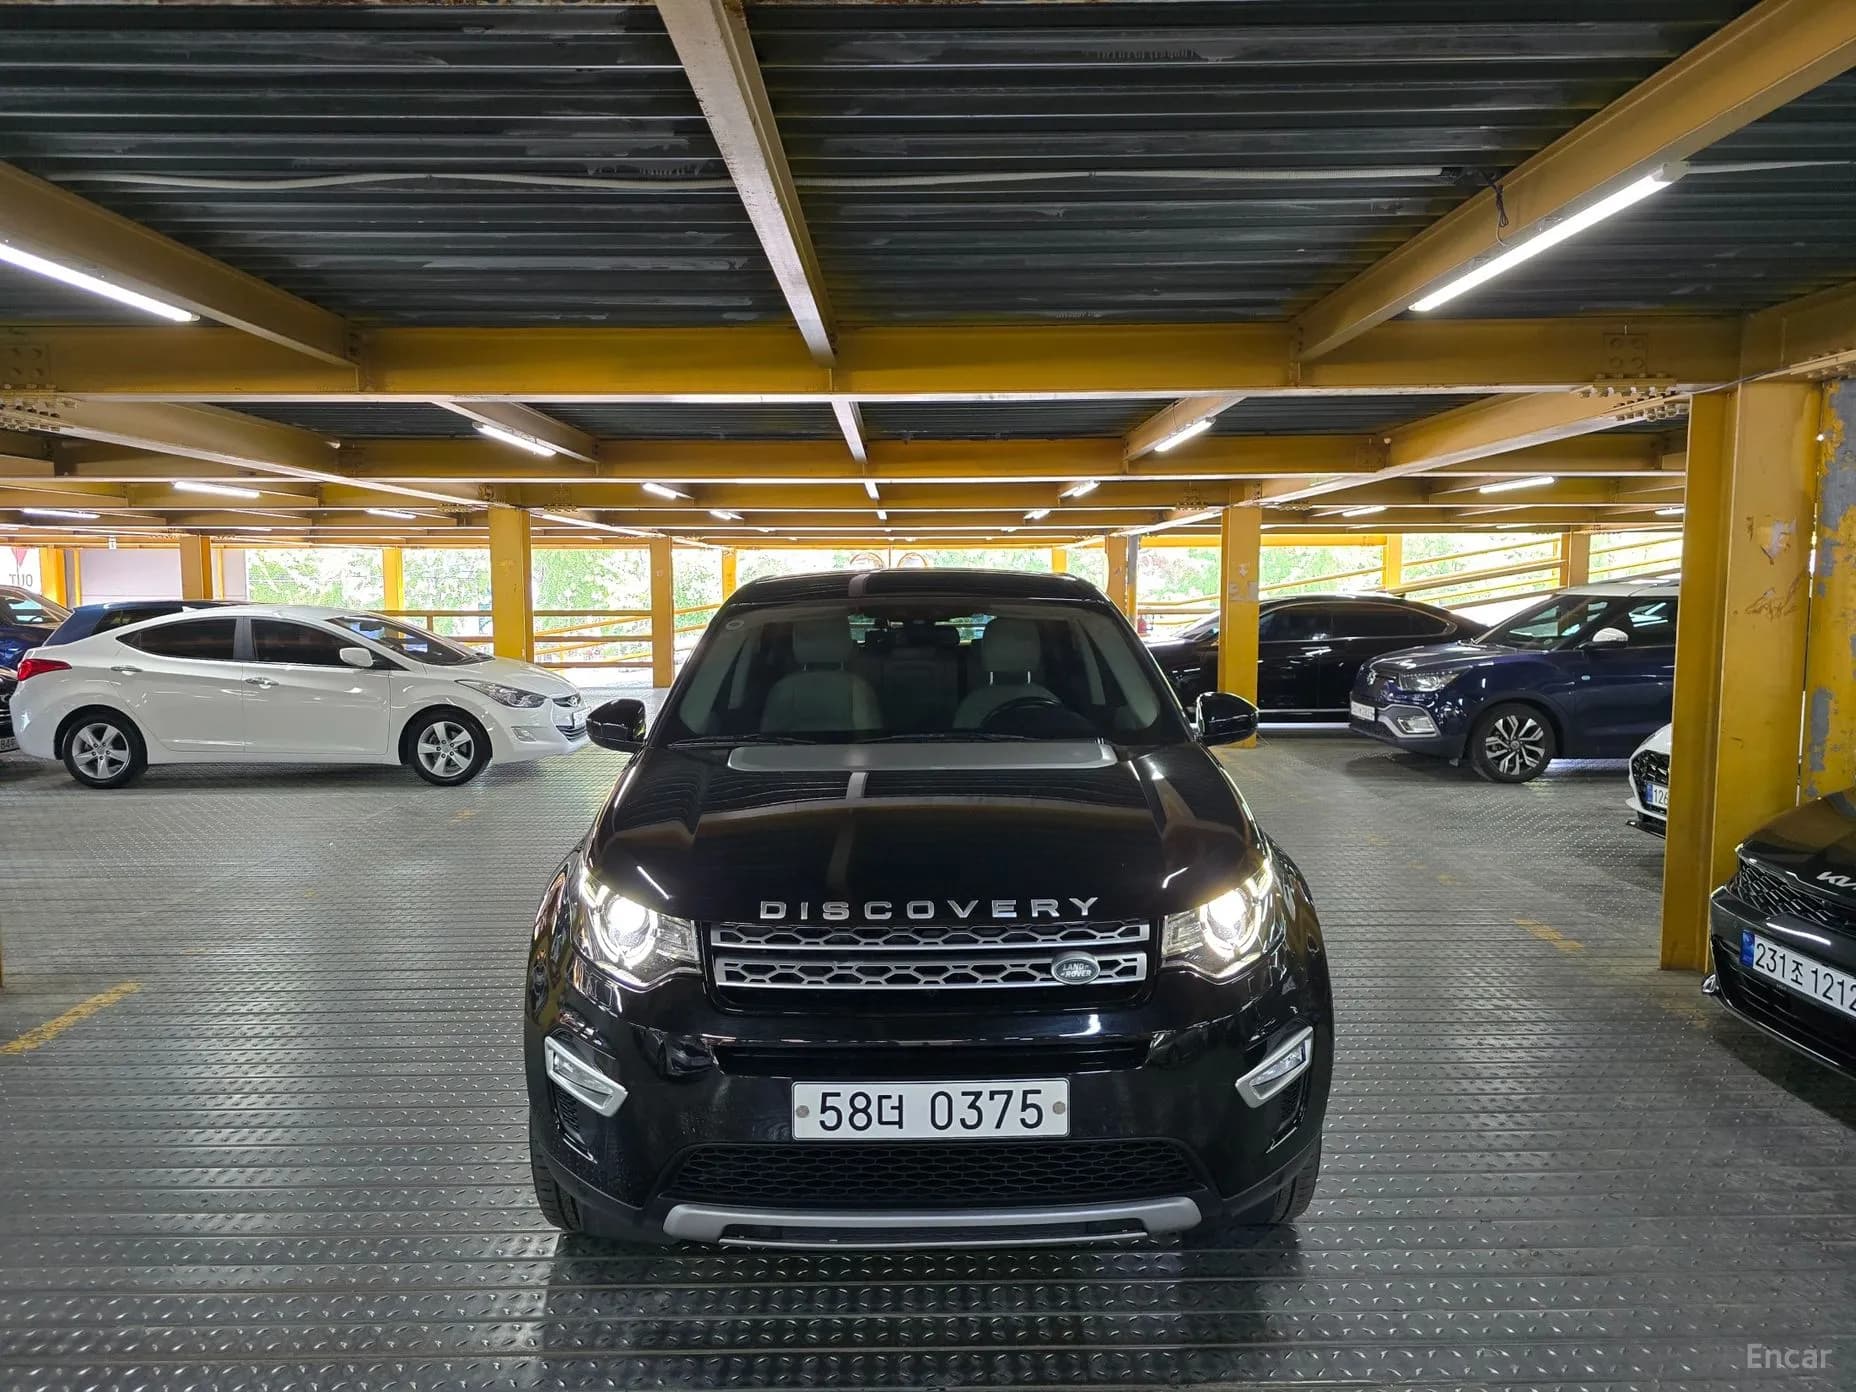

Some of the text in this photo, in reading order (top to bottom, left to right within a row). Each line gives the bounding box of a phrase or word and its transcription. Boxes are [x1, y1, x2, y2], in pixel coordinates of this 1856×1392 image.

[759, 897, 1099, 921] DISCOVERY
[1062, 962, 1084, 971] LAND
[1065, 969, 1092, 978] ROVER
[1755, 942, 1804, 986] 231조
[818, 1089, 1044, 1132] 58더 0375
